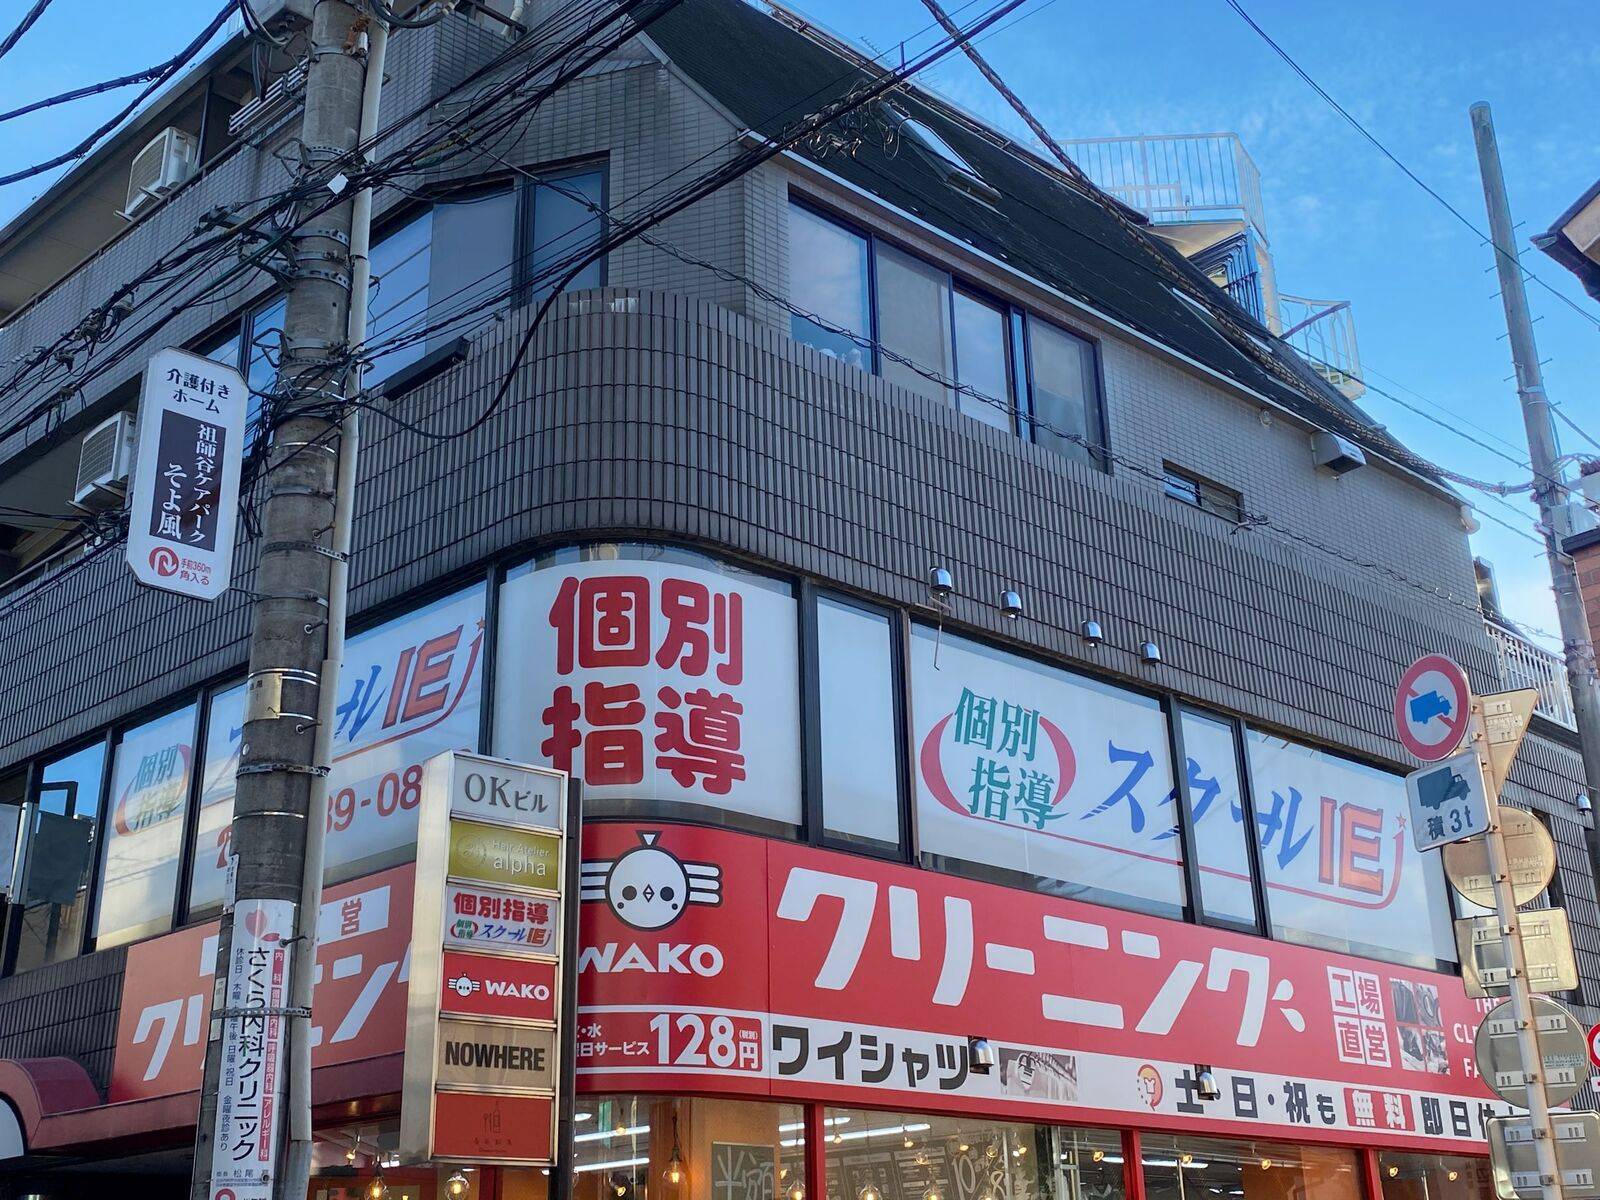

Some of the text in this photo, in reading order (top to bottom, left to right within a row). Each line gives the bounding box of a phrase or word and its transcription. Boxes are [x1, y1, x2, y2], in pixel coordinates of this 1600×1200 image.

[166, 367, 231, 400] 介護付き
[173, 388, 220, 414] ホーム
[157, 462, 187, 540] そよ風
[189, 424, 217, 543] 祖師谷ケアパーク
[180, 570, 209, 586] 角入る
[549, 576, 743, 686] 個別
[541, 682, 746, 795] 指導
[953, 686, 1041, 762] 個別
[968, 755, 1069, 830] 指導
[493, 856, 547, 877] alpha
[454, 892, 549, 925] 個別指導
[578, 943, 724, 978] WAKO
[776, 866, 1306, 1047] クリーニング
[485, 979, 550, 1001] WAKO
[1332, 974, 1382, 1016] 工場
[232, 947, 270, 1161] さくら内科クリニック
[445, 1041, 545, 1071] NOWHERE
[650, 1013, 737, 1068] 128
[772, 1024, 970, 1090] ワイシャツ
[1338, 1021, 1388, 1064] 直営
[259, 1098, 273, 1160] アレルギー科
[1351, 1088, 1406, 1130] 無料
